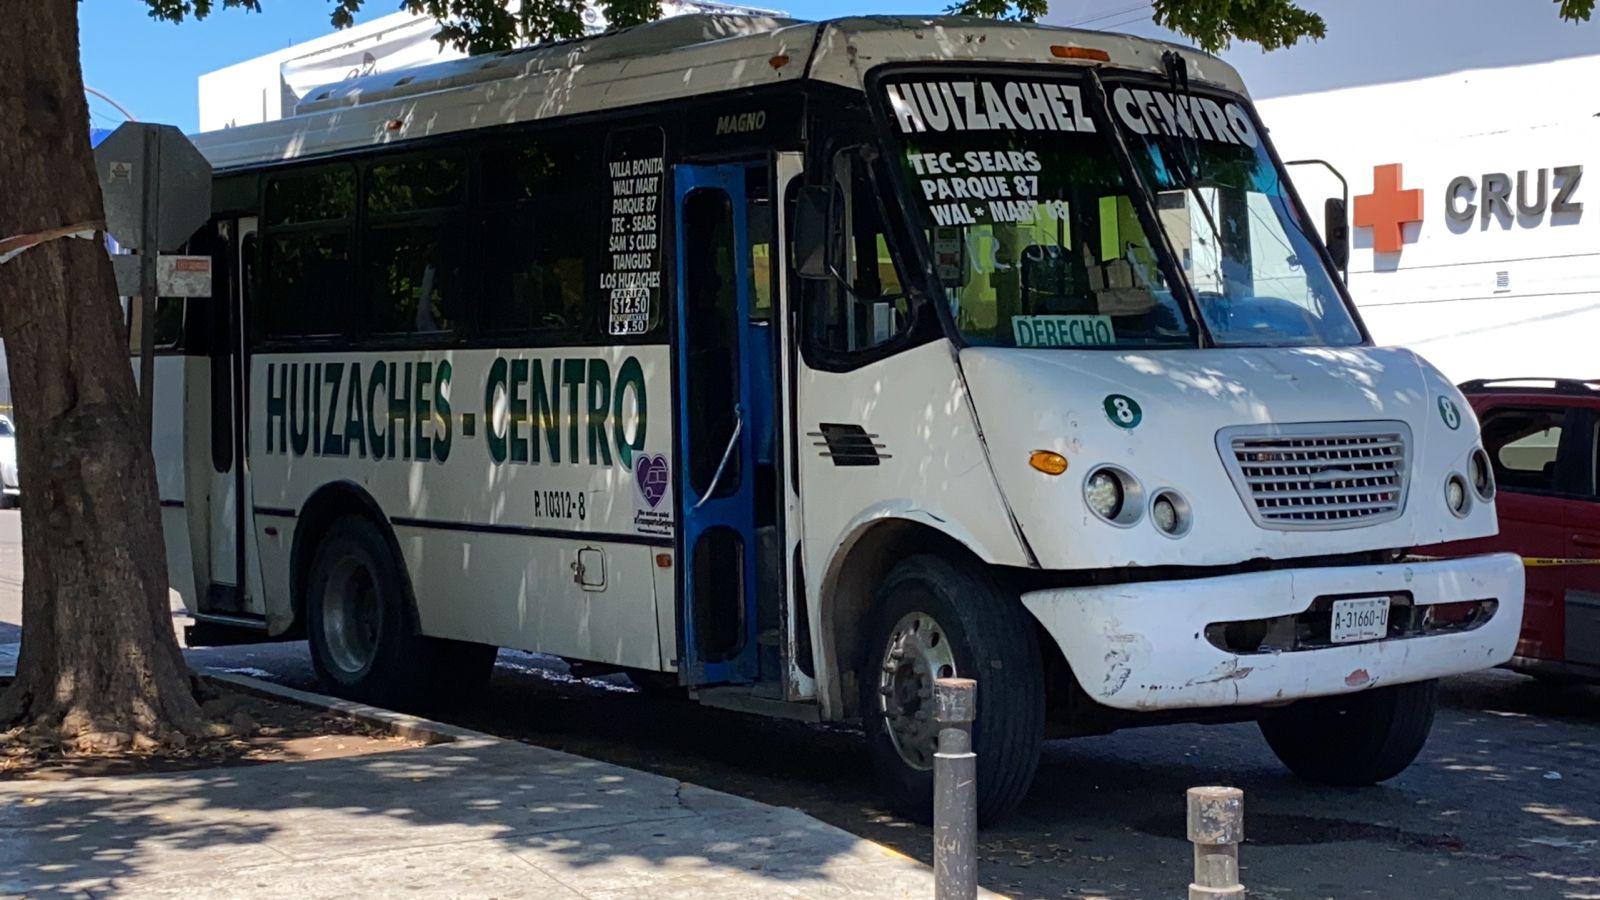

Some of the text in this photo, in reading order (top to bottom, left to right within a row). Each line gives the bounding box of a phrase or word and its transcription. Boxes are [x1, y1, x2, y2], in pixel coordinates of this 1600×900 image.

[716, 110, 766, 135] MAGNO
[885, 81, 1258, 149] HUIZACHEZ CENTRO
[609, 158, 664, 178] VILLA BONITA
[906, 151, 1042, 175] TEC-SEARS
[612, 177, 659, 196] WALT MART
[920, 175, 1038, 200] PARQUE 87
[1444, 164, 1584, 221] CRUZ
[612, 196, 657, 214] PARQUE 87
[988, 200, 1041, 222] MART
[611, 217, 625, 233] TEC
[632, 215, 657, 232] SEARS
[636, 234, 657, 251] CLUB
[612, 253, 652, 270] TIANGUIS
[600, 272, 617, 289] LOS
[614, 289, 647, 298] TARIFA
[612, 297, 647, 314] $12.50
[1016, 319, 1111, 346] DERECHO
[267, 359, 453, 464] HUIZACHES
[485, 355, 647, 472] CENTRO
[1113, 398, 1134, 423] 8
[1441, 397, 1458, 428] 8
[1335, 608, 1387, 630] A-31660-U
